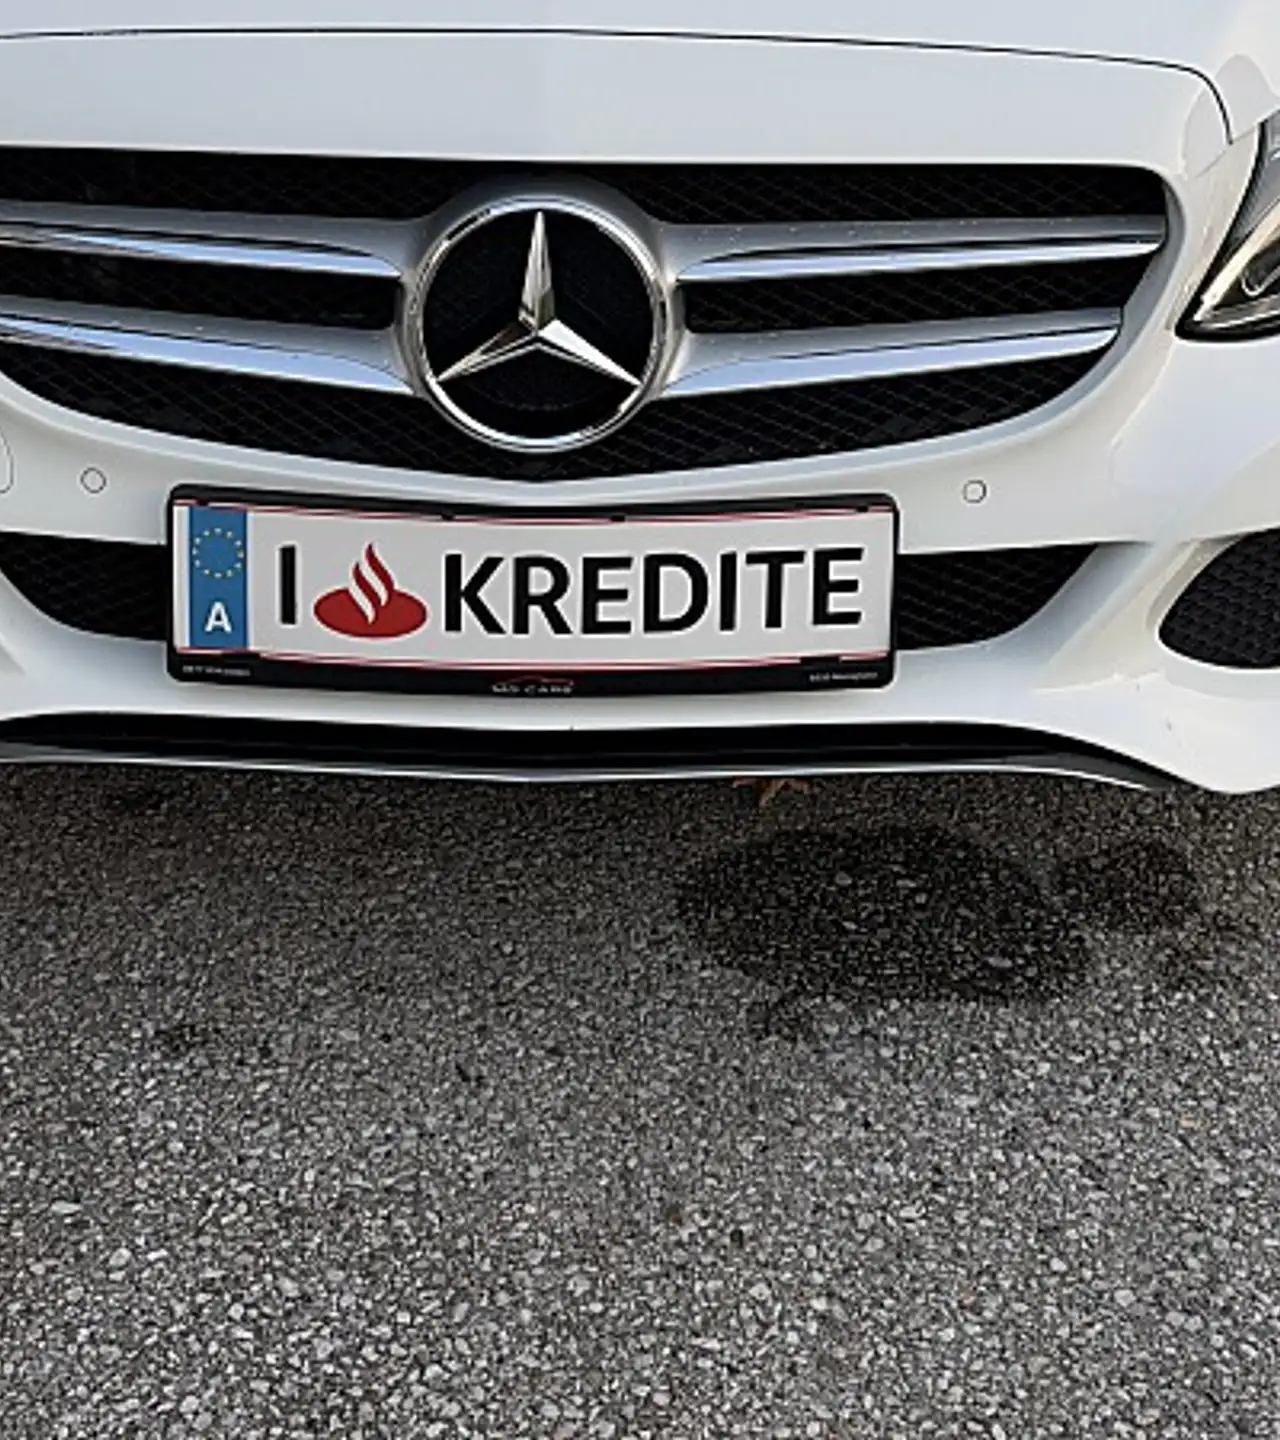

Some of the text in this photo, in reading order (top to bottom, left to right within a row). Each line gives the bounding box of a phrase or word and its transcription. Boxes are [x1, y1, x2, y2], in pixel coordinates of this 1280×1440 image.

[205, 602, 232, 632] A
[278, 544, 865, 635] I KREDITE
